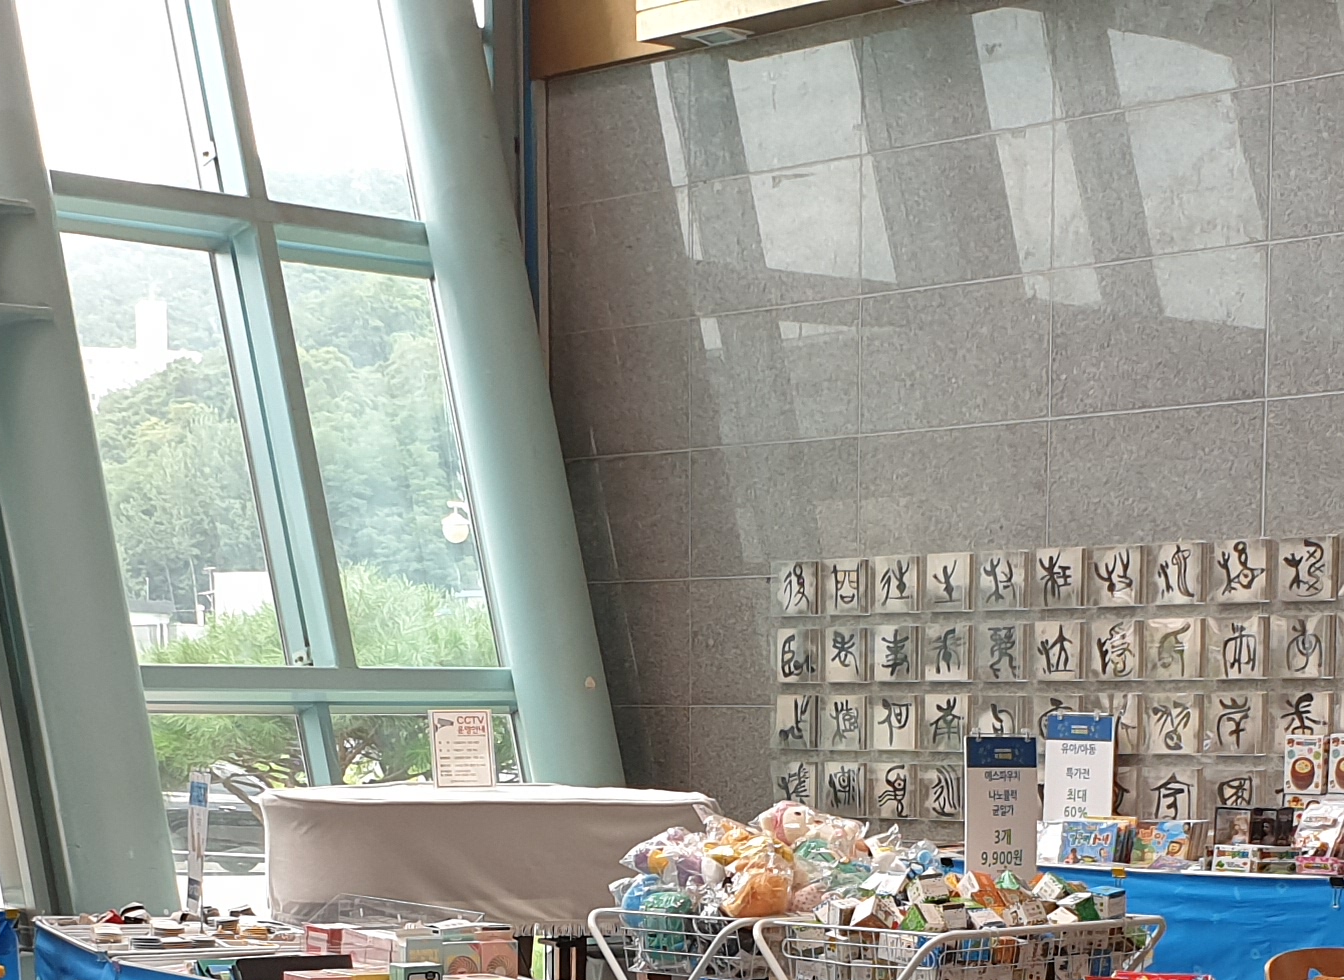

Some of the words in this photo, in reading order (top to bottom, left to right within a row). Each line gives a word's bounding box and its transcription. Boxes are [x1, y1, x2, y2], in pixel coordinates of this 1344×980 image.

[456, 715, 485, 725] CCTV
[1067, 789, 1087, 802] 최대
[1064, 806, 1088, 818] 60%
[994, 828, 1012, 845] 3개
[981, 849, 1023, 868] 9,900원
